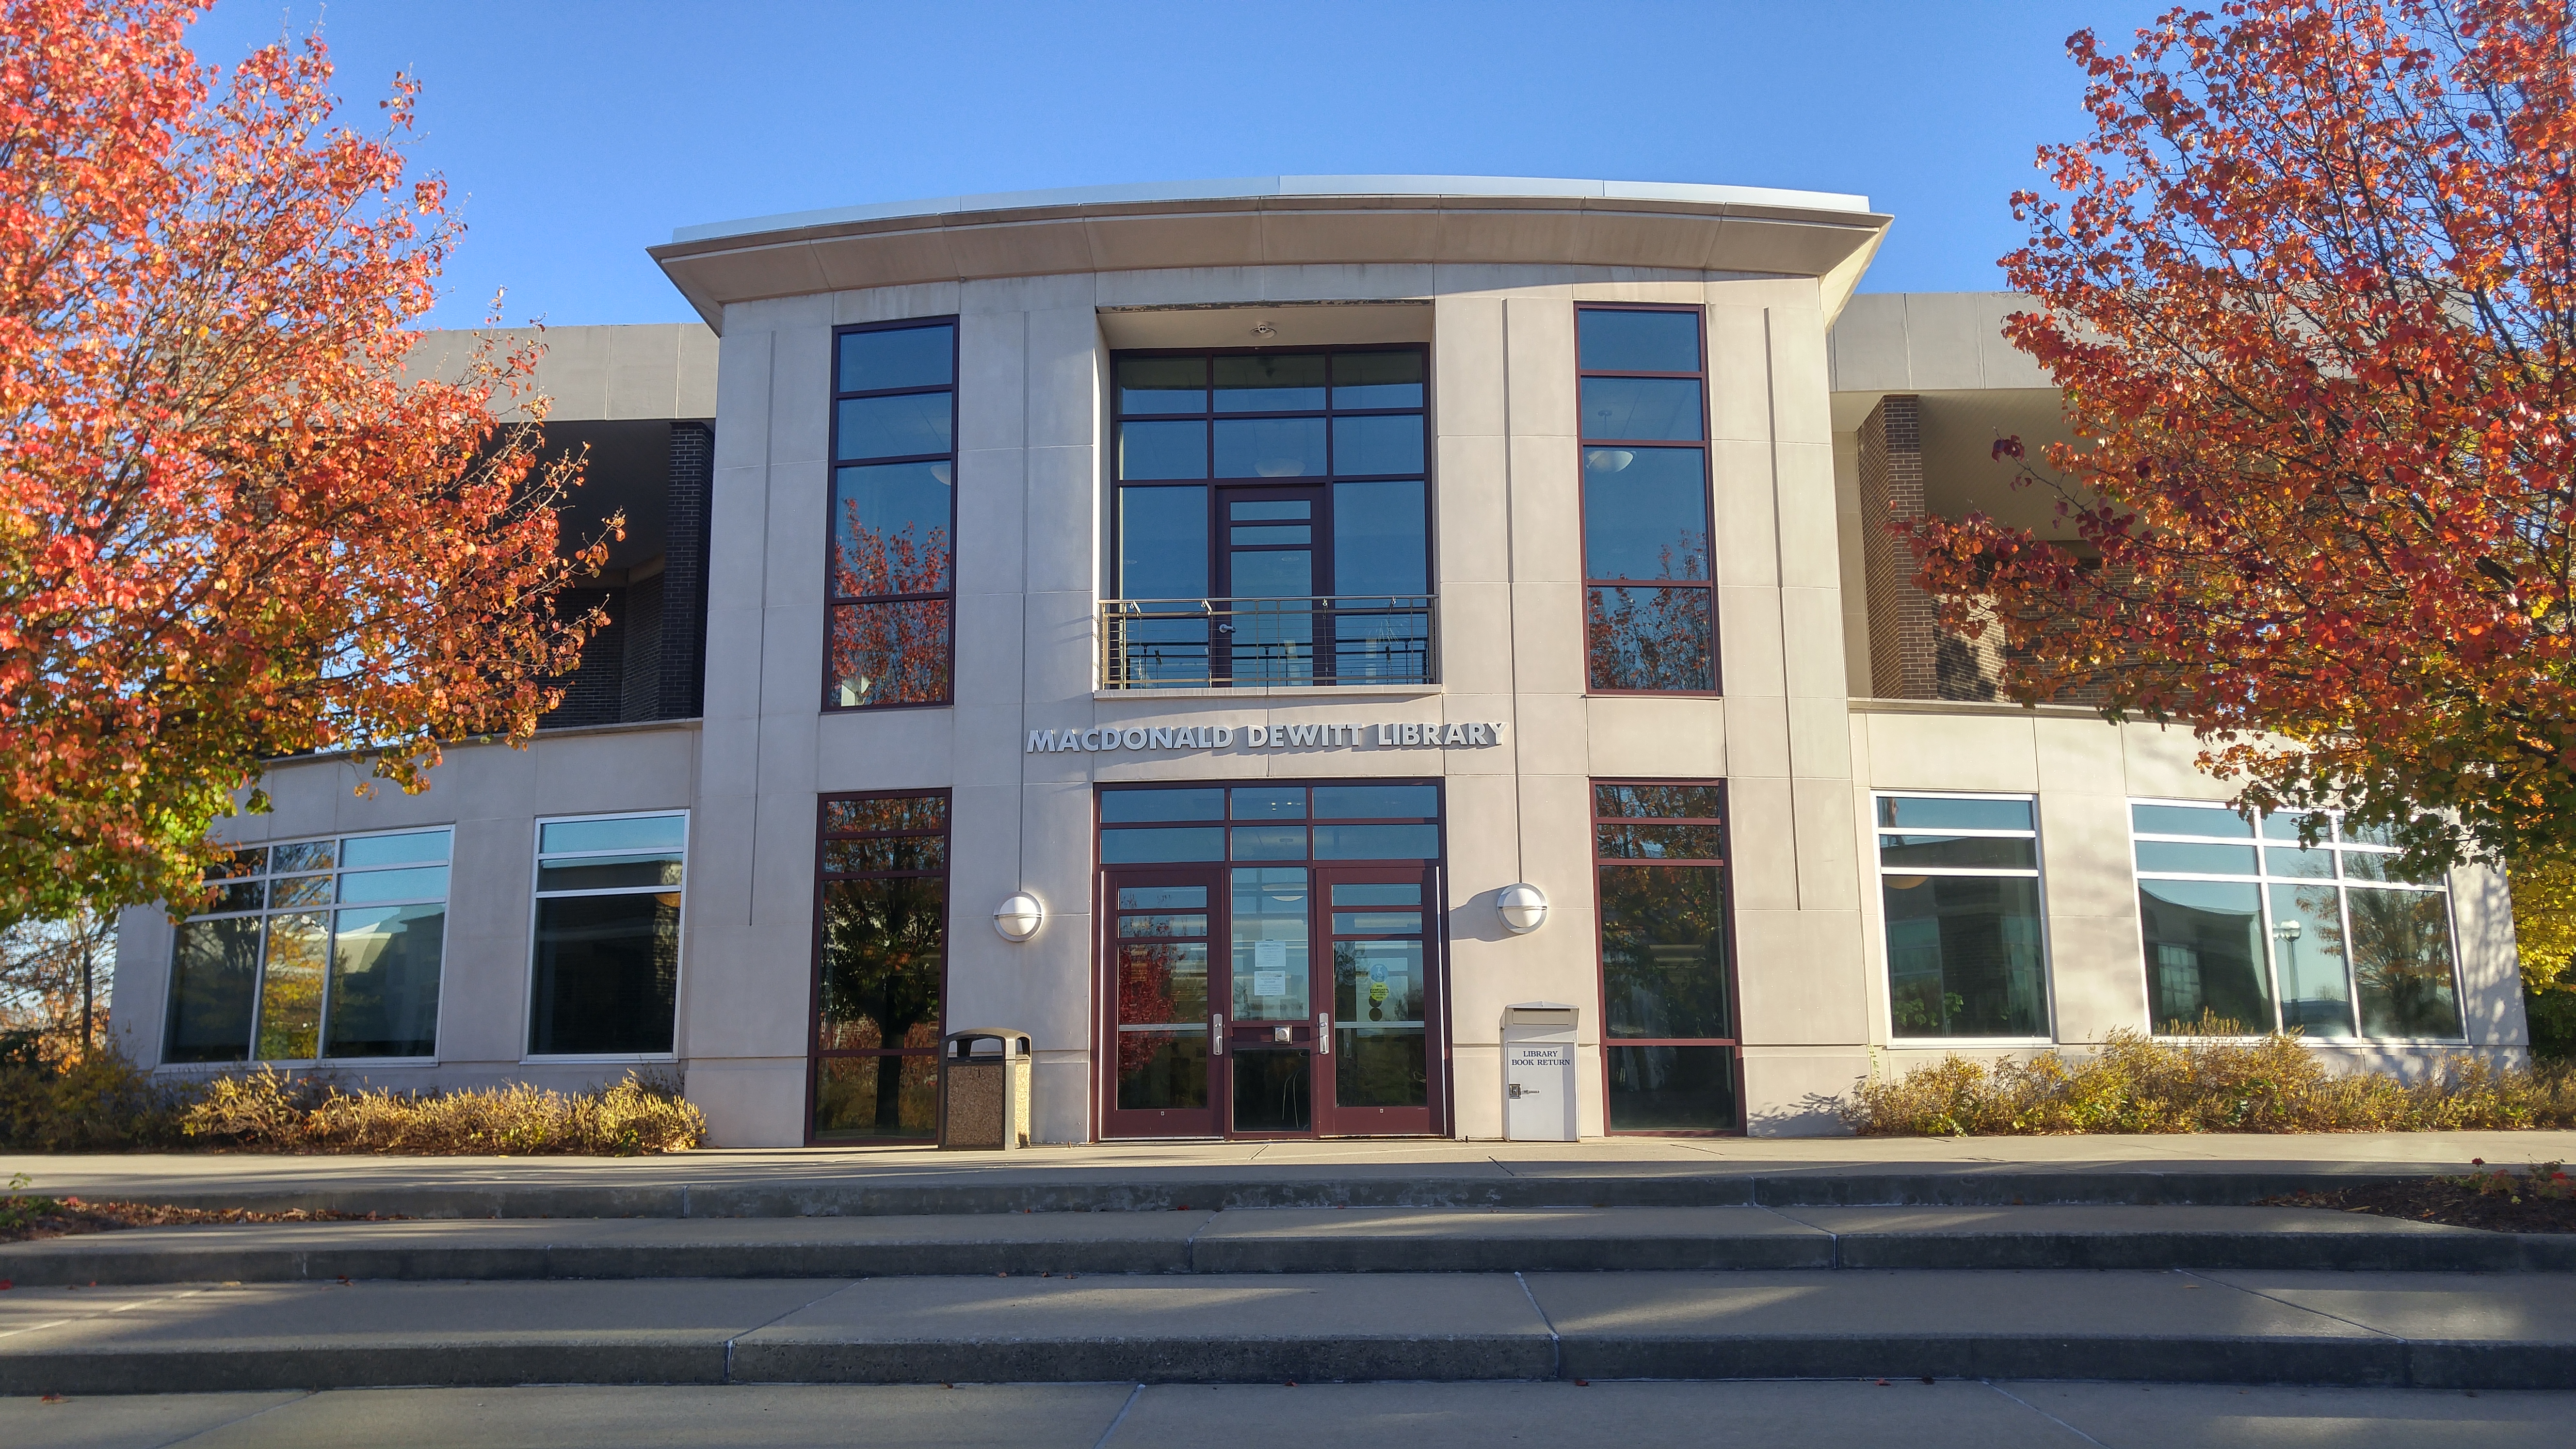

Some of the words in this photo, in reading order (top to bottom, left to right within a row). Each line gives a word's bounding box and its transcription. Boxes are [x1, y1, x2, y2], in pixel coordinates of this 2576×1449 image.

[1026, 725, 1234, 752] MACDONALD
[1247, 723, 1363, 747] DEWITT
[1378, 722, 1508, 746] LIBRARY
